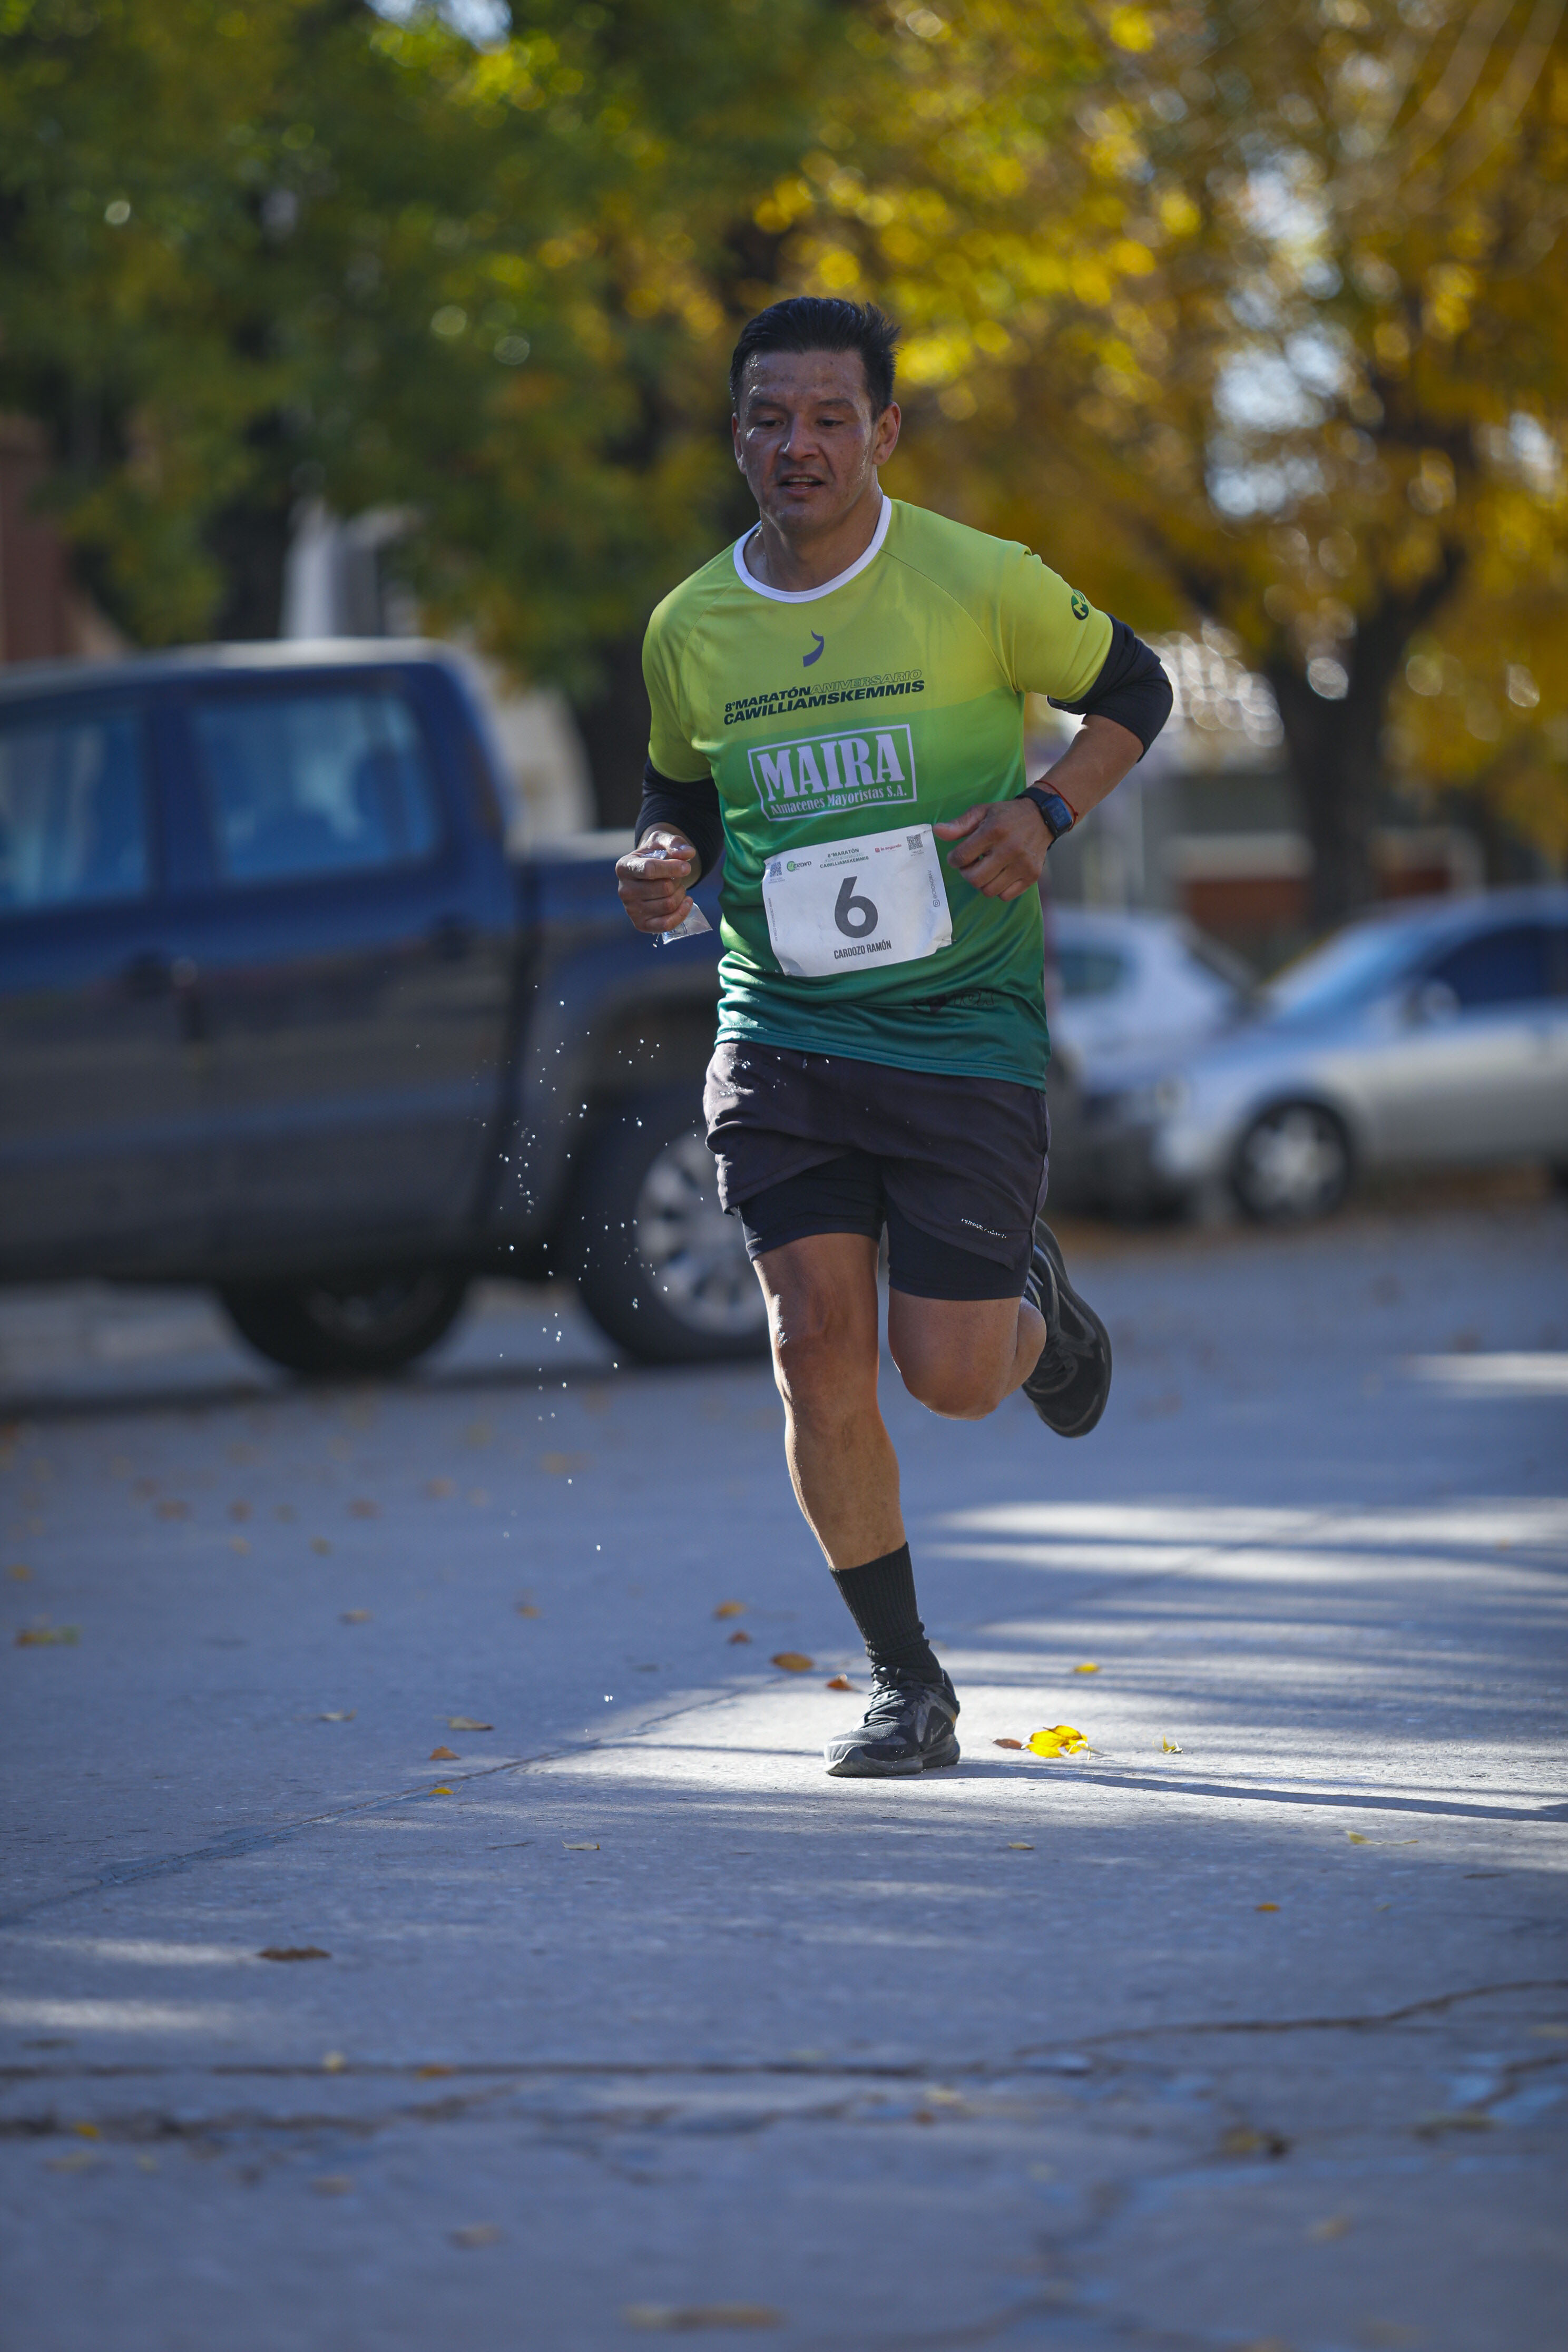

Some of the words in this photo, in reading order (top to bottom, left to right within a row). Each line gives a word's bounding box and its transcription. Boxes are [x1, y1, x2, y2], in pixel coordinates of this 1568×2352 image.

[723, 680, 925, 725] CAWILLIAMSKEMMIS
[757, 733, 905, 801] MAIRA
[770, 797, 825, 815] Almacenes
[827, 787, 884, 807] Mayoristas
[887, 785, 907, 797] S.A.
[834, 875, 878, 938] 6
[834, 945, 866, 959] CARDOZO
[866, 939, 892, 953] RAMÓN
